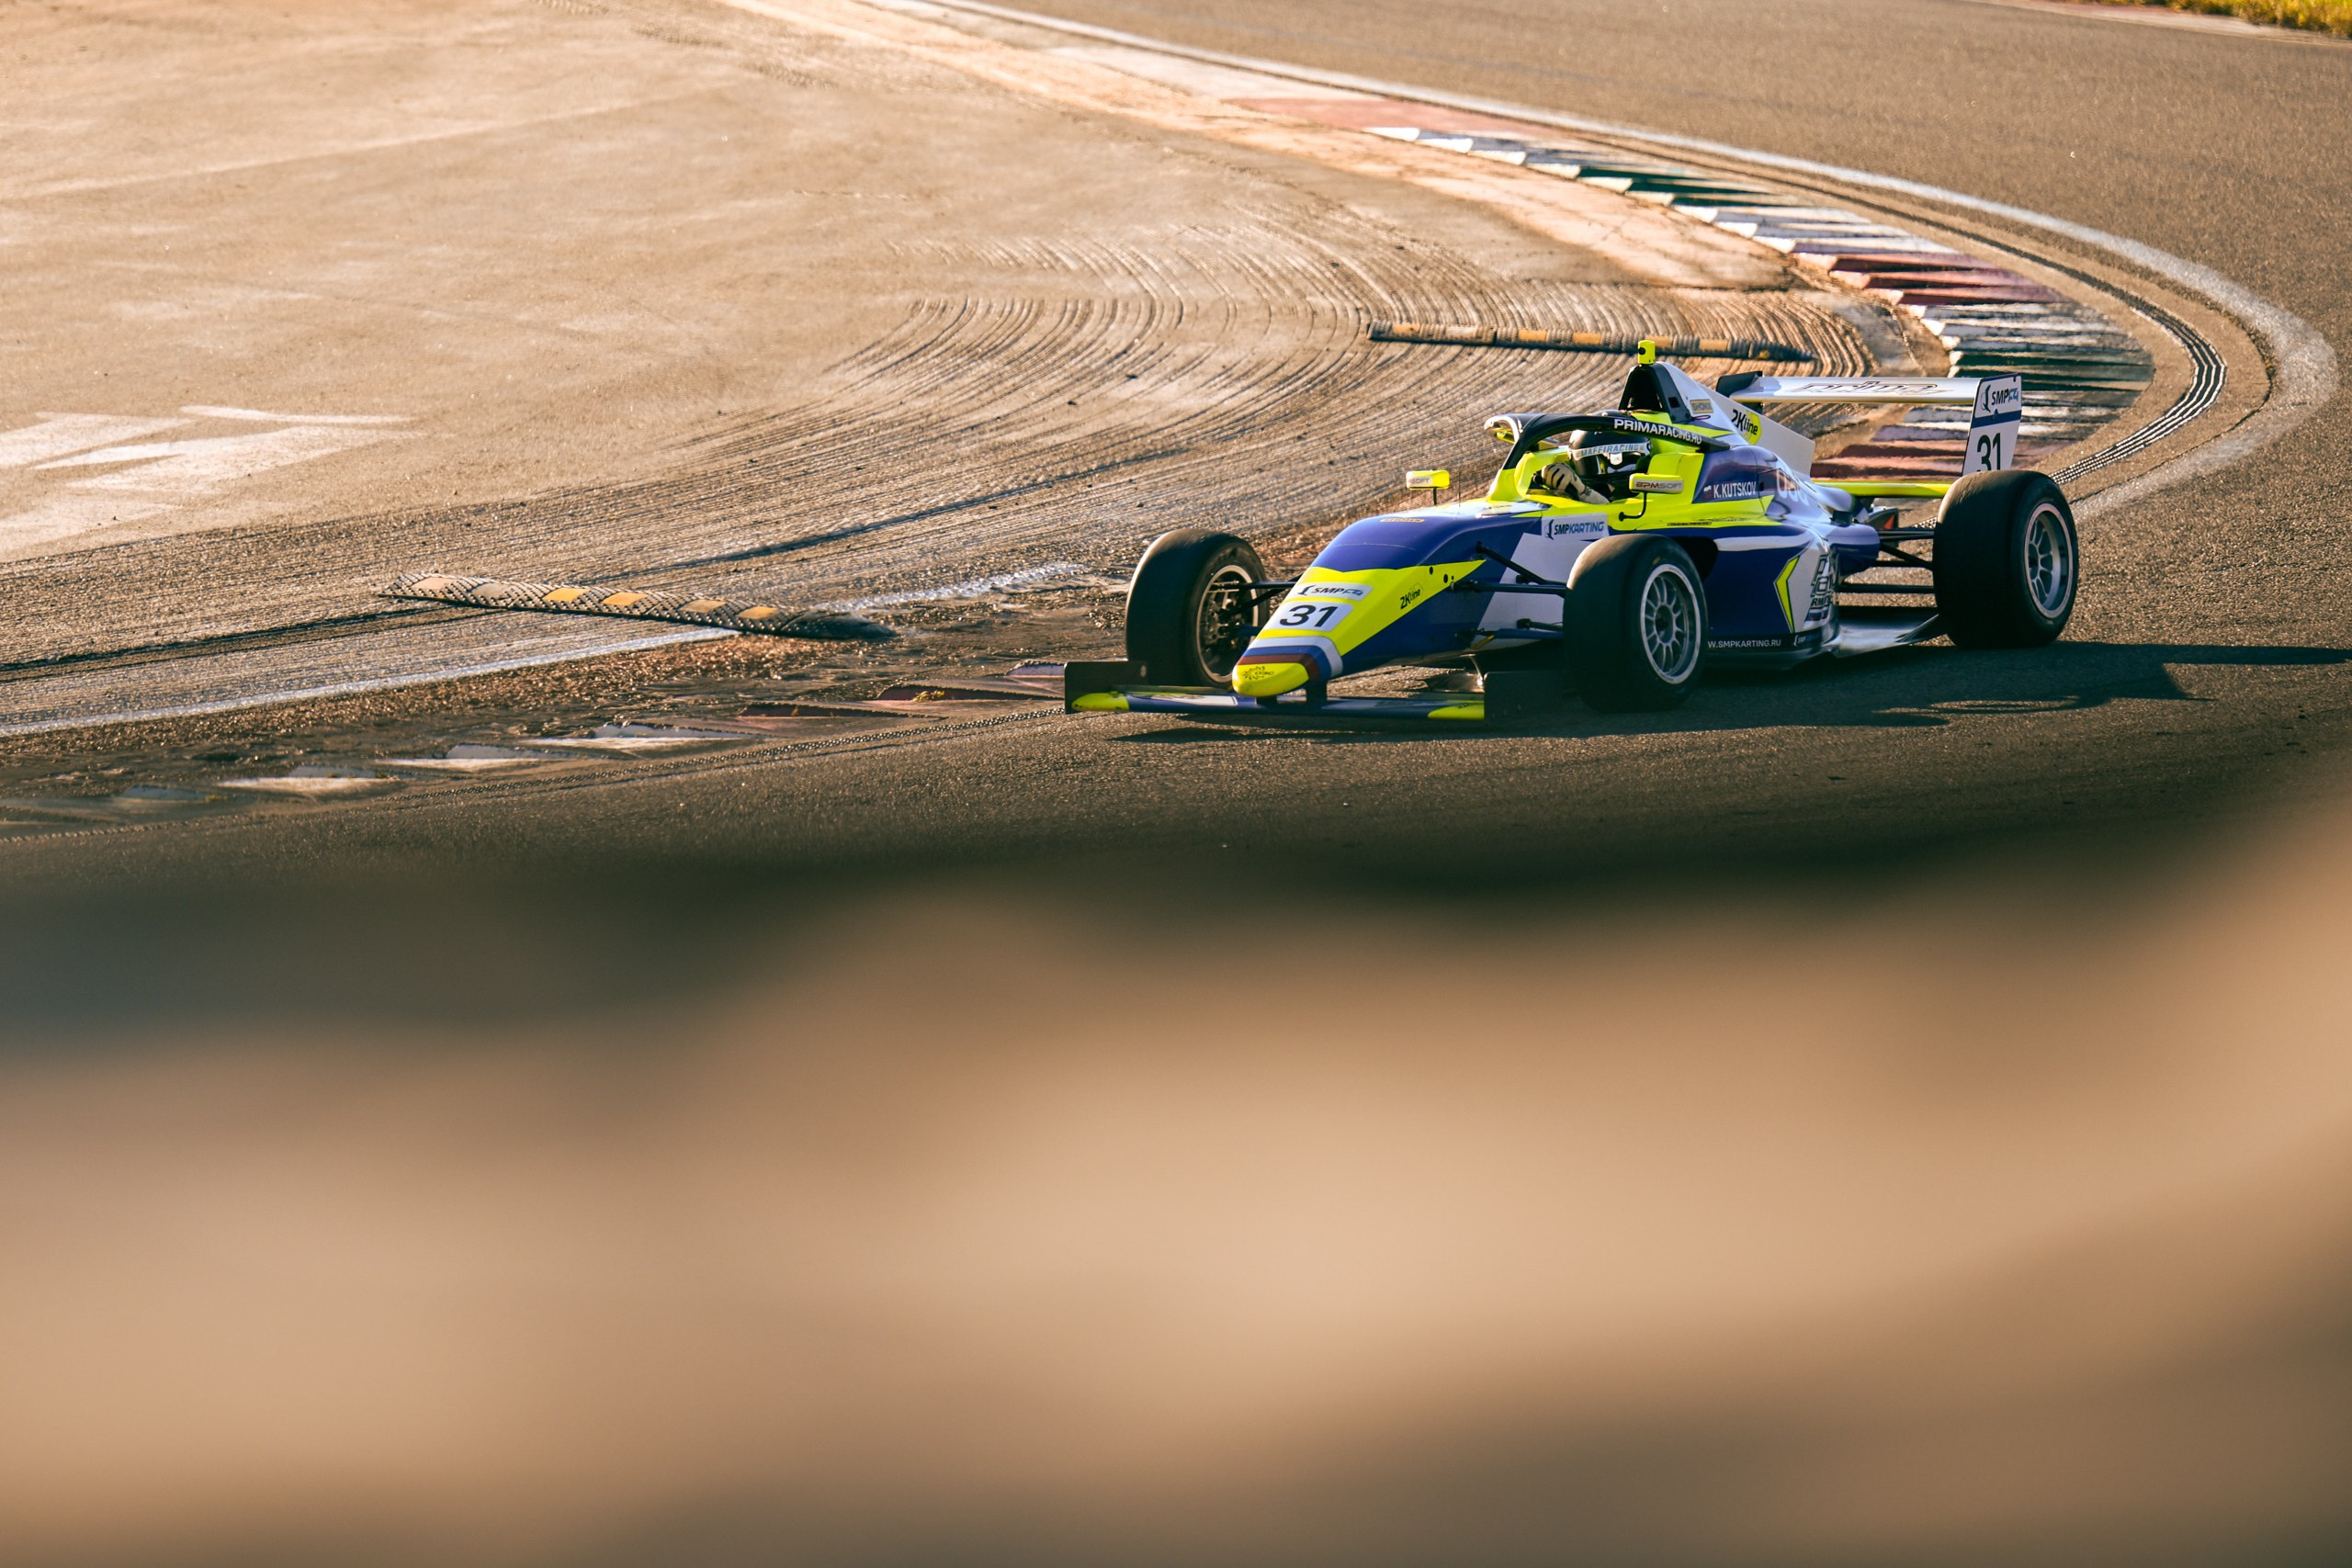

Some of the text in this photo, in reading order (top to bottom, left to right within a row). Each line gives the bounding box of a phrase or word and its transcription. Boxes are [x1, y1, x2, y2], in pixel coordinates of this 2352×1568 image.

[1976, 433, 2001, 471] 31
[1555, 521, 1604, 535] SMPKARTING
[1279, 604, 1338, 627] 31
